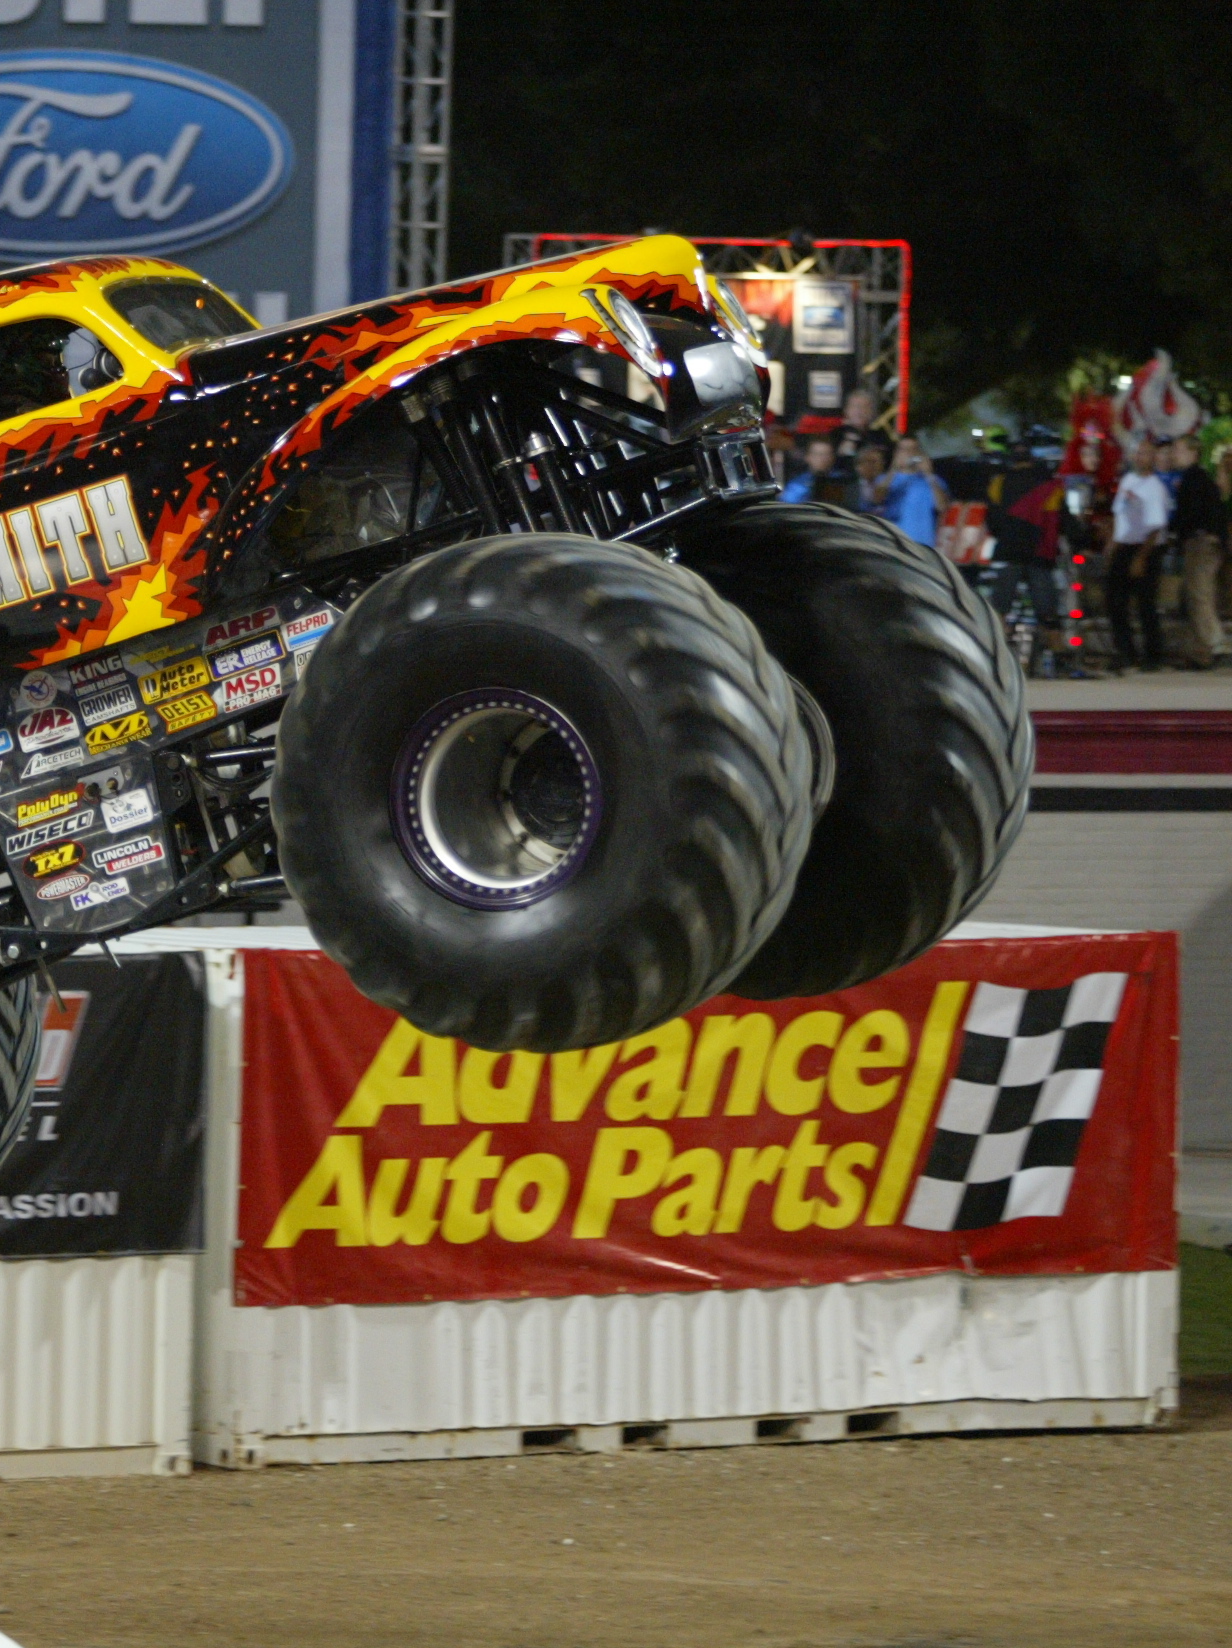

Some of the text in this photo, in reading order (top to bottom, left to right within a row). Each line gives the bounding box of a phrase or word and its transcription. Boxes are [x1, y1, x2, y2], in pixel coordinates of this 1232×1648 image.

[206, 607, 276, 646] ARP
[286, 612, 329, 637] FEL-PRO
[241, 640, 272, 657] ENERGY
[243, 647, 278, 666] RELEASE
[69, 655, 124, 684] KING
[160, 663, 195, 684] Auto
[161, 671, 205, 693] Meter
[224, 667, 277, 700] MSD
[81, 686, 135, 718] CROWER
[85, 702, 136, 725] CAMSHAFTS
[161, 693, 209, 720] DEIST
[19, 708, 74, 737] JAZ
[170, 709, 214, 730] SAFETY
[17, 791, 78, 818] PolyDyn
[109, 807, 148, 825] Dossier
[8, 811, 91, 852] WISECO
[96, 840, 149, 864] LINCOLN
[111, 850, 157, 870] WELDERS
[40, 875, 86, 897] POWERMASTER
[73, 892, 94, 908] FK
[263, 1120, 878, 1248] Auto Parts
